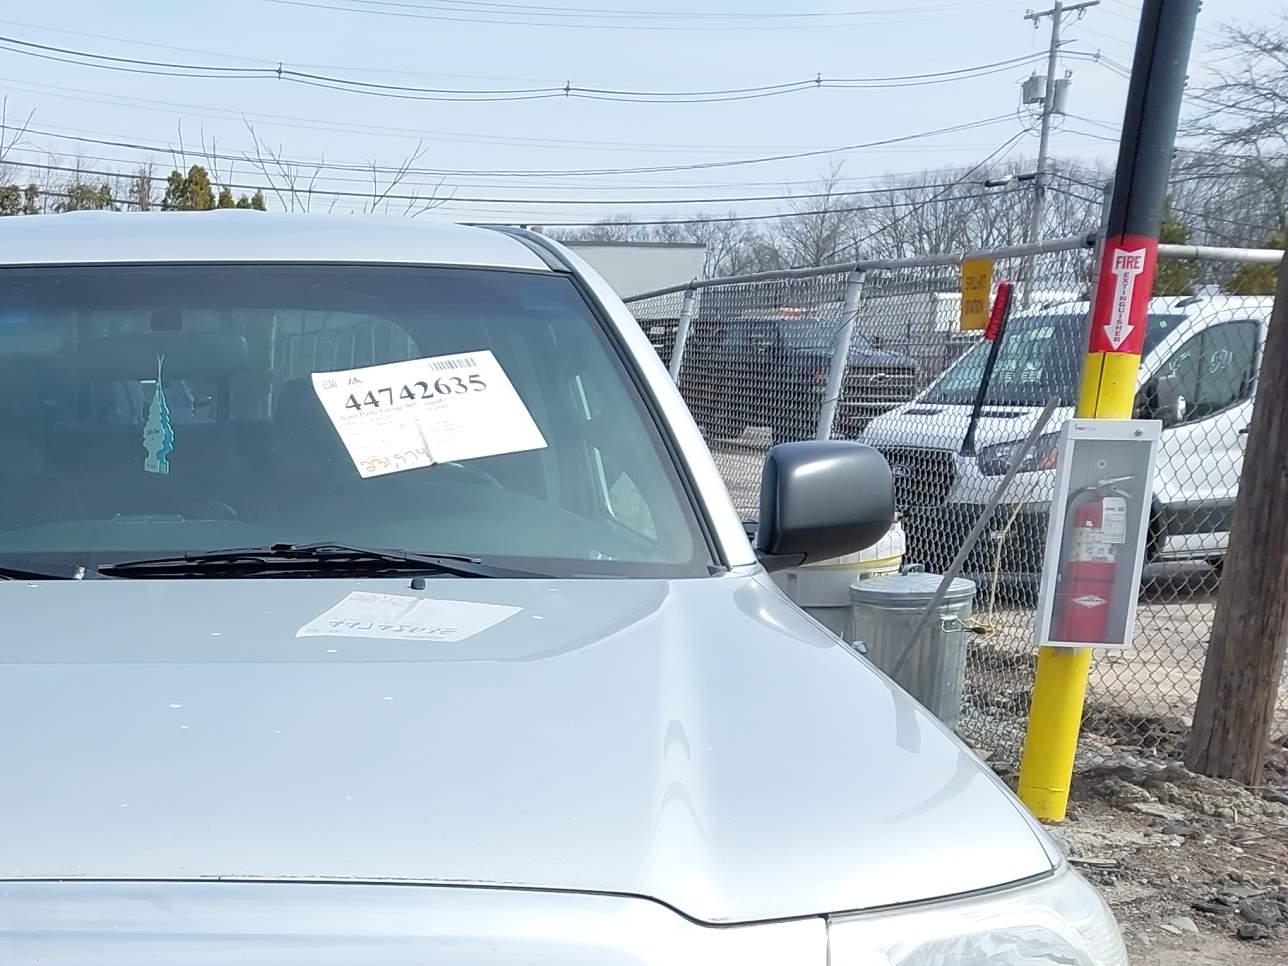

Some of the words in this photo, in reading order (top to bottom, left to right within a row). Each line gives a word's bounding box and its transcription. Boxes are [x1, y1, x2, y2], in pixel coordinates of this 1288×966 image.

[1115, 256, 1141, 269] FIRE
[1114, 272, 1129, 342] EXTINGUISHER
[345, 374, 487, 410] 44742635
